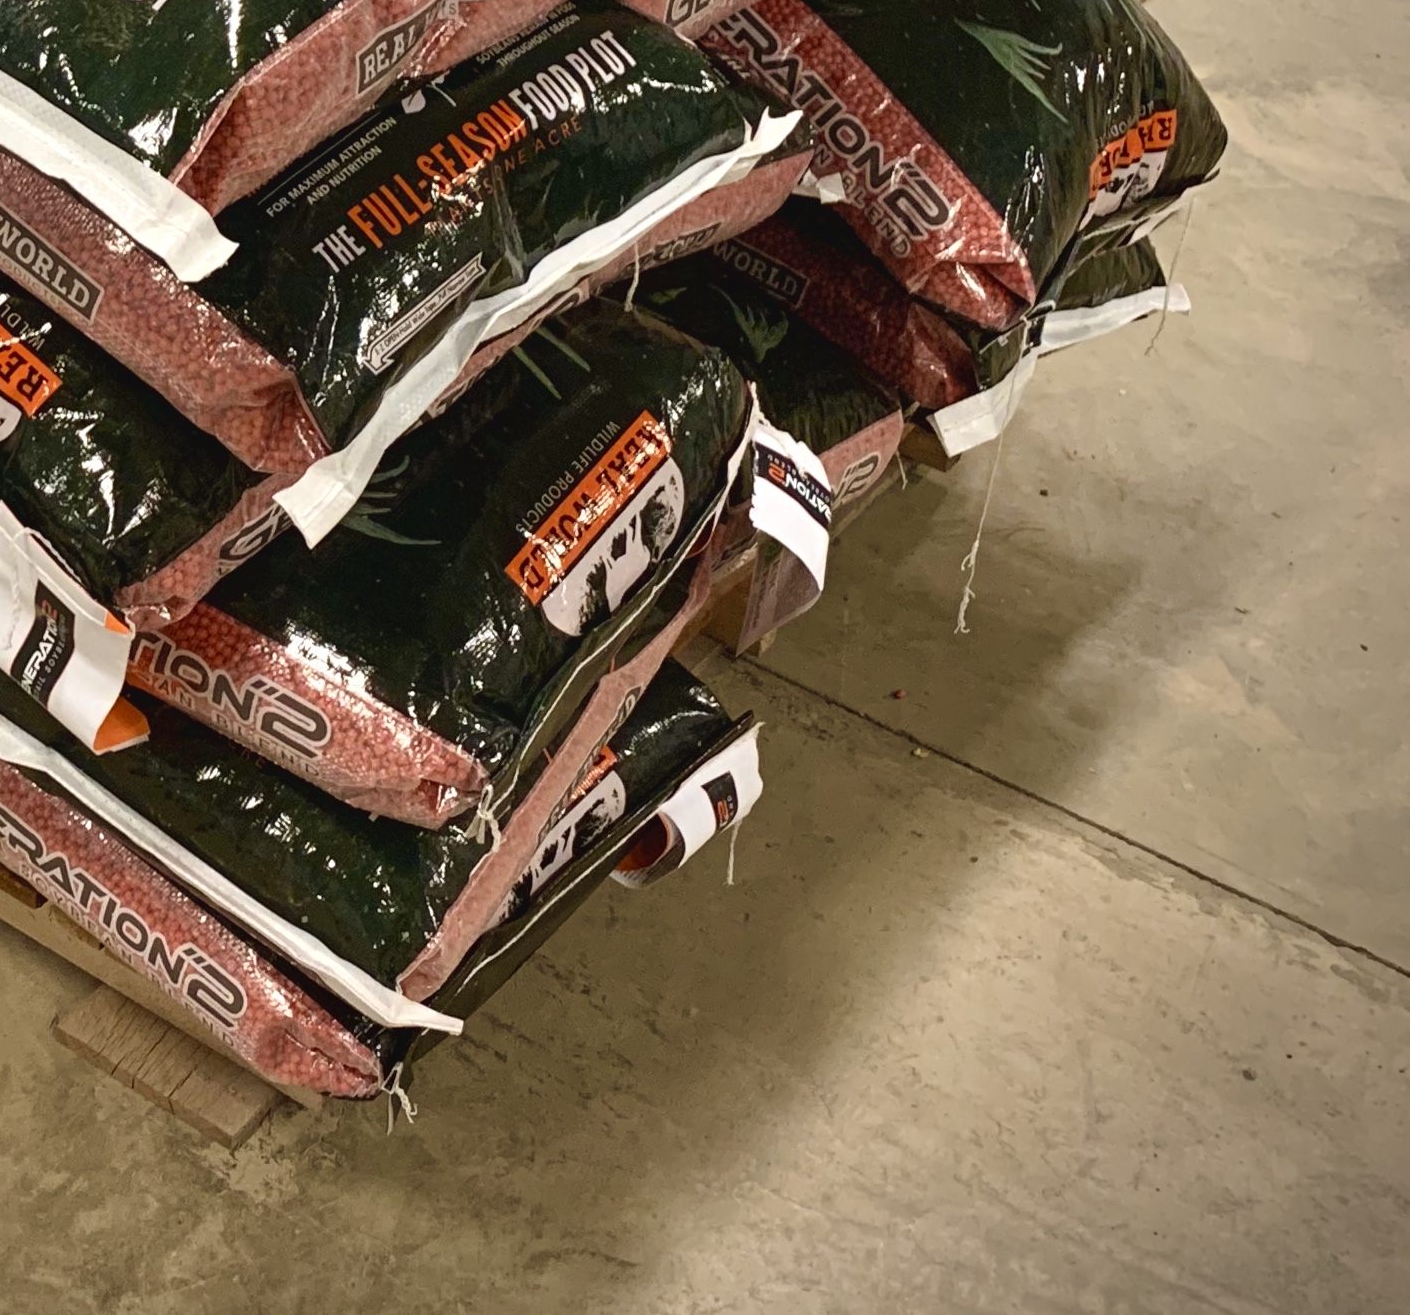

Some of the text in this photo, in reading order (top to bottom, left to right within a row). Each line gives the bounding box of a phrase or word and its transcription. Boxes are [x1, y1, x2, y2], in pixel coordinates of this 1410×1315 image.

[496, 13, 581, 67] THROUGHOUT SEASON
[265, 116, 398, 218] FOR MAXIMUM ATTRACTION
[305, 144, 383, 206] AND NUTRITION
[311, 29, 638, 275] THE FULL-SEASON FOOD PLOT
[534, 114, 583, 156] ACRE
[713, 240, 799, 297] WORLD
[515, 420, 621, 535] WILDLIFE PRODUCTS
[19, 862, 134, 964] SOYBEAN
